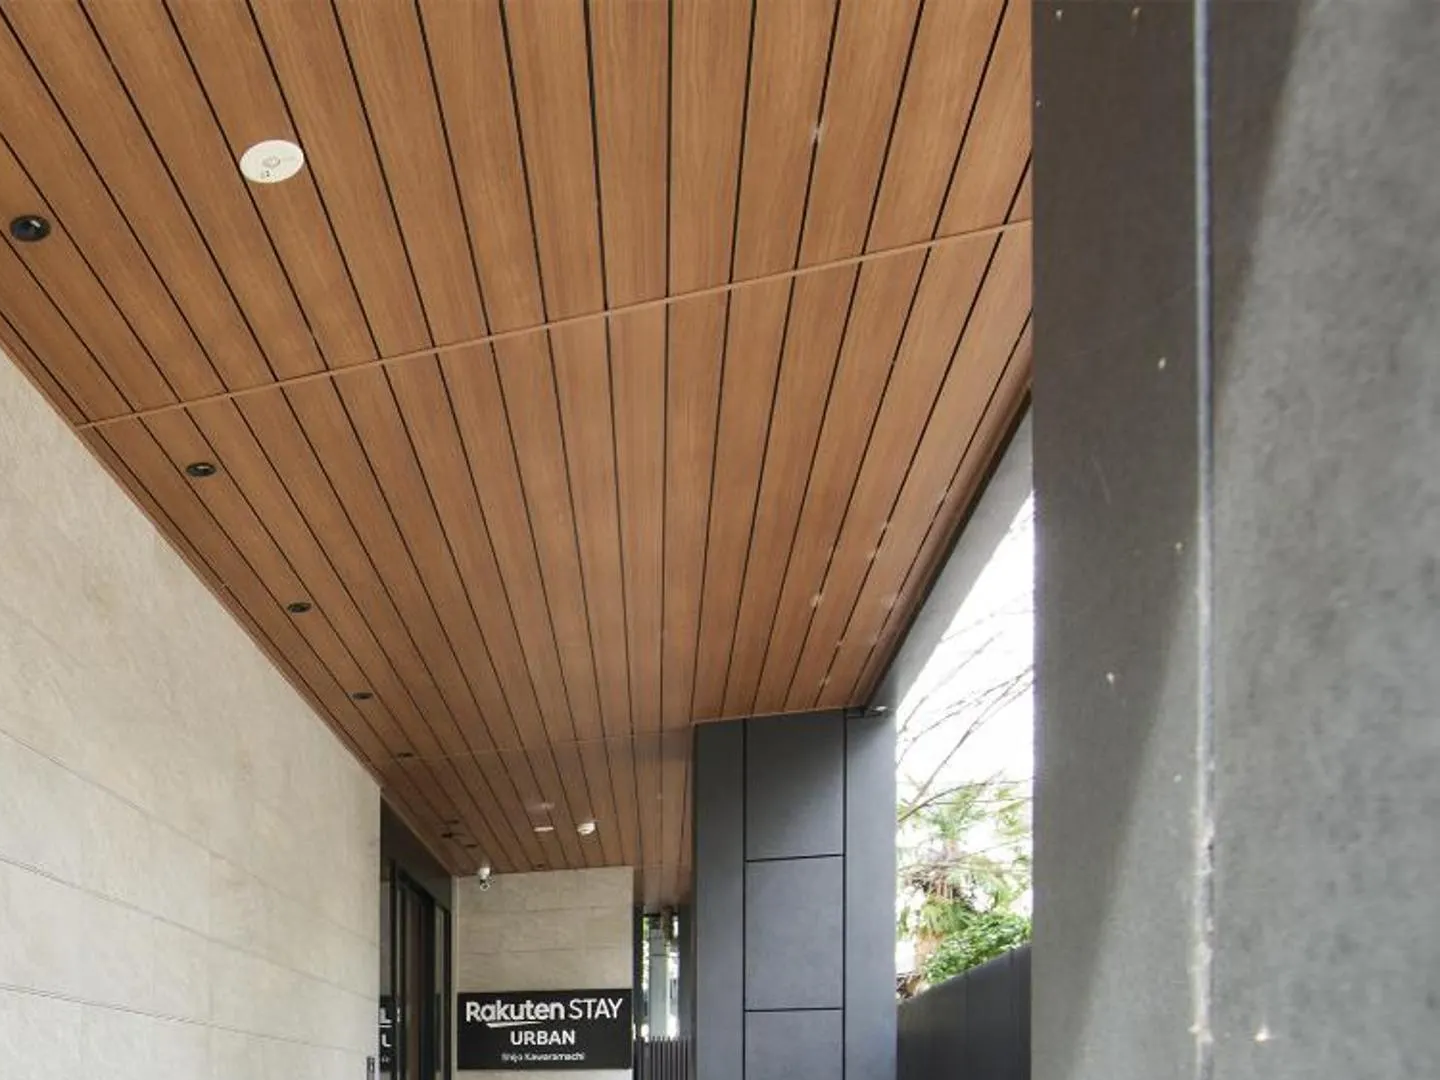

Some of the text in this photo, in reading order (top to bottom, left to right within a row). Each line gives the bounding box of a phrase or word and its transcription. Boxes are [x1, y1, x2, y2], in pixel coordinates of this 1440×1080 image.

[465, 997, 623, 1023] Rakuten STAY
[510, 1028, 576, 1046] URBAN
